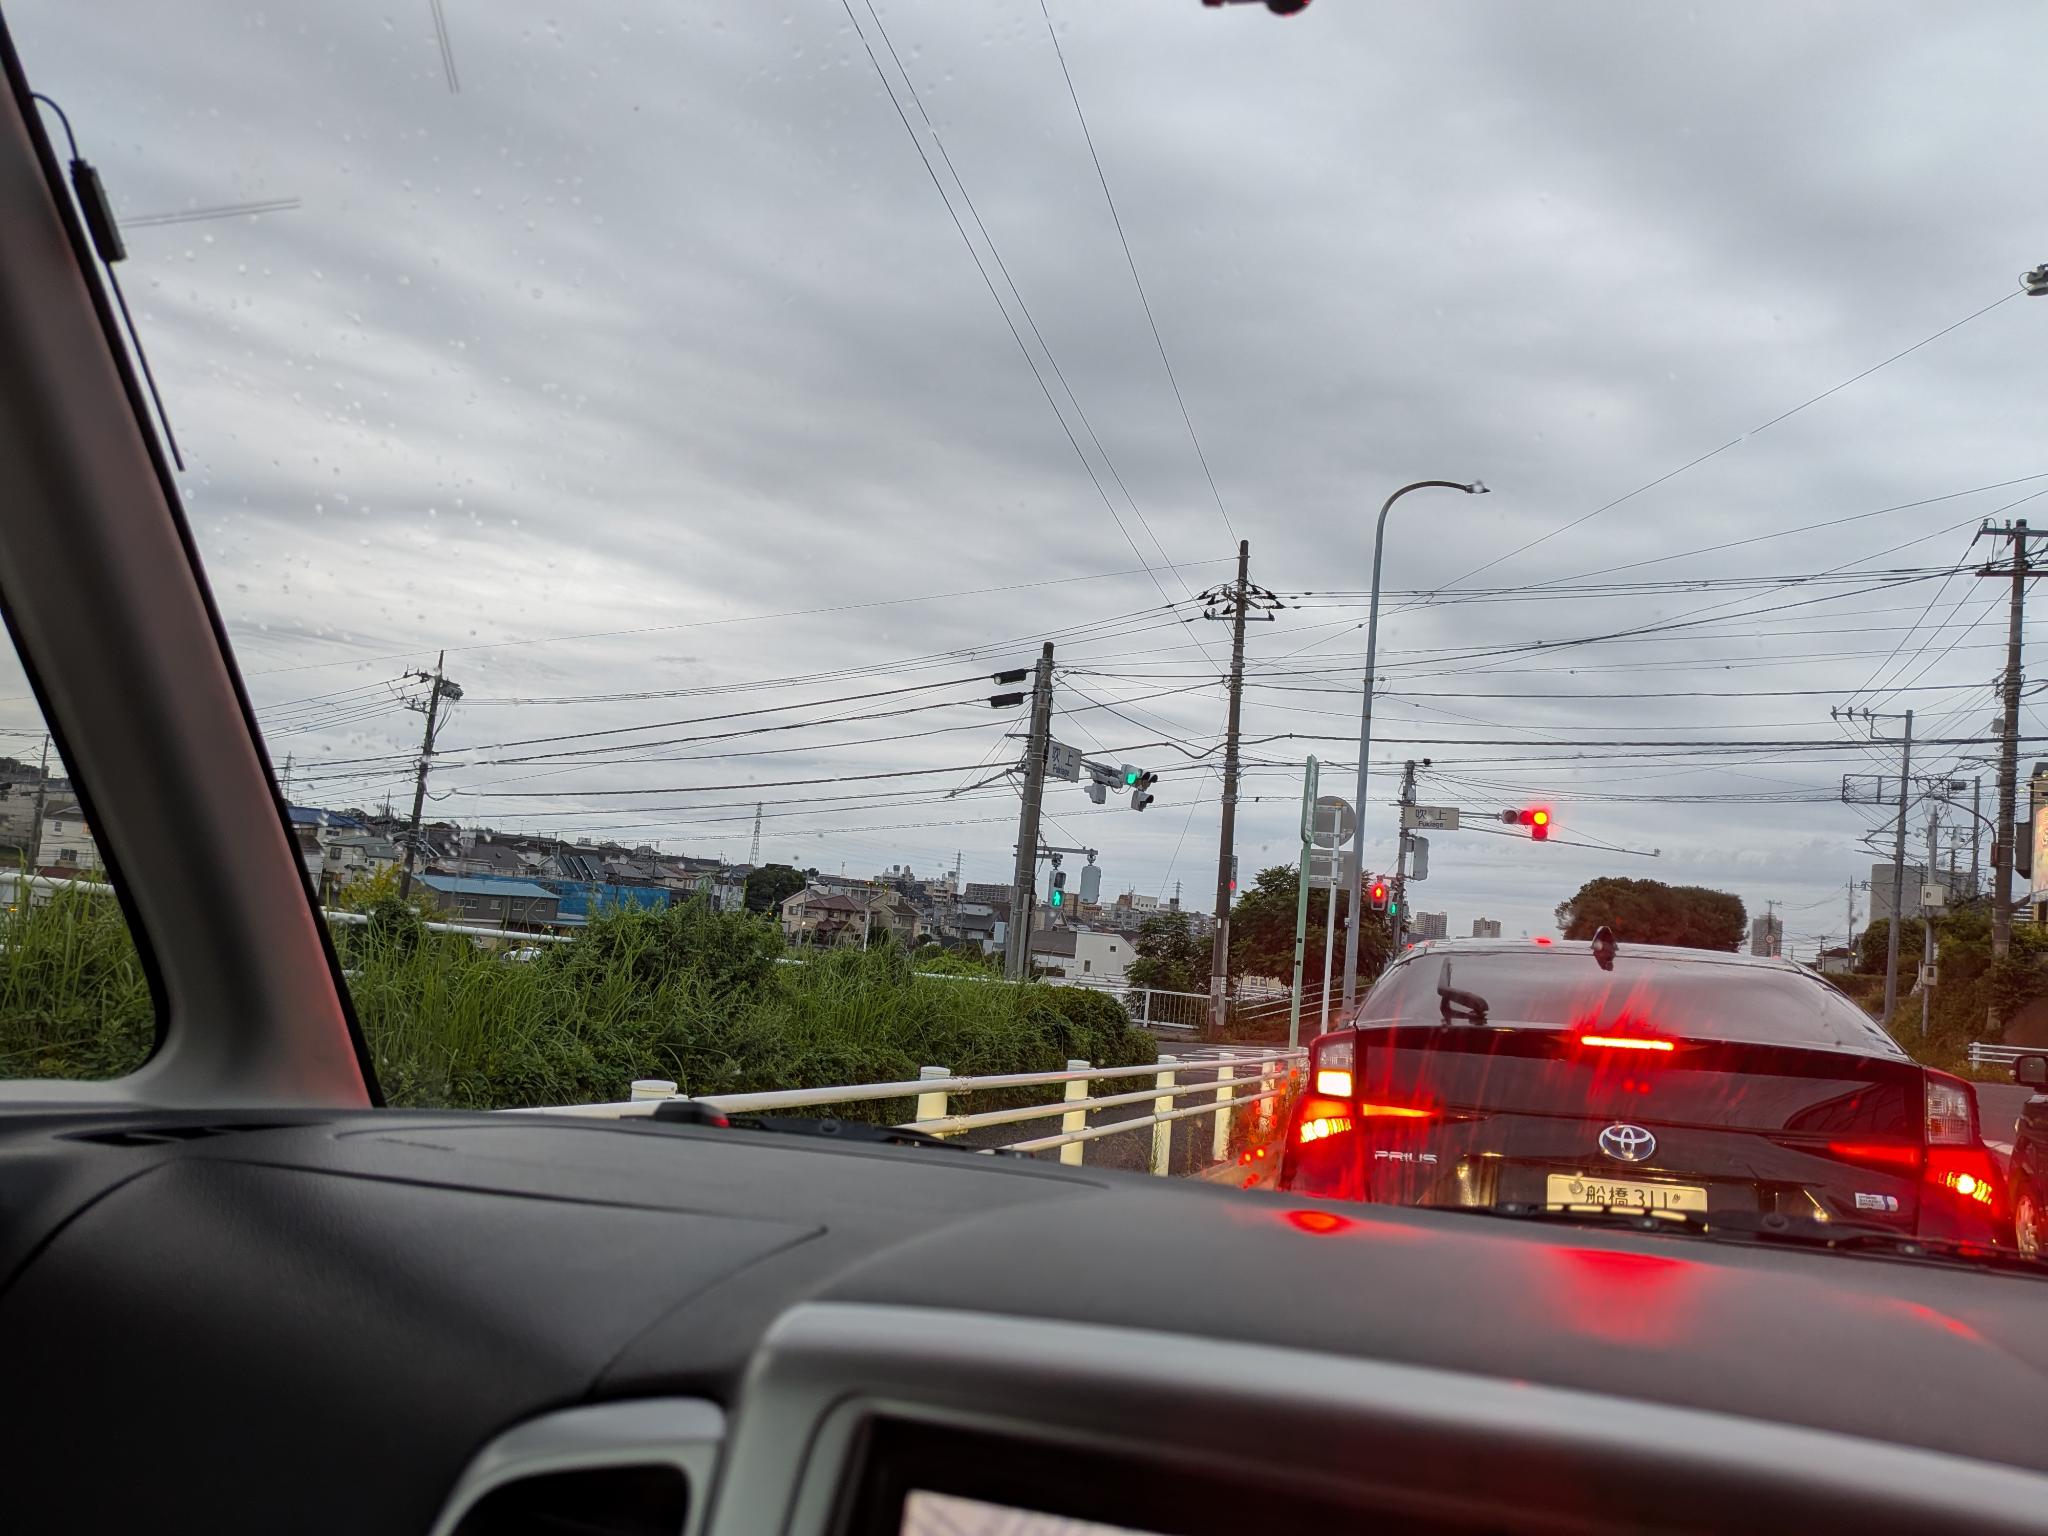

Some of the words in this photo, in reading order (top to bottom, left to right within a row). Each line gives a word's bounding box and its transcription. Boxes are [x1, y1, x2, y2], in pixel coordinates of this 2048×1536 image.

[1052, 746, 1073, 767] 吹上
[1416, 809, 1447, 820] 吹上
[1374, 1150, 1438, 1164] PRIUS
